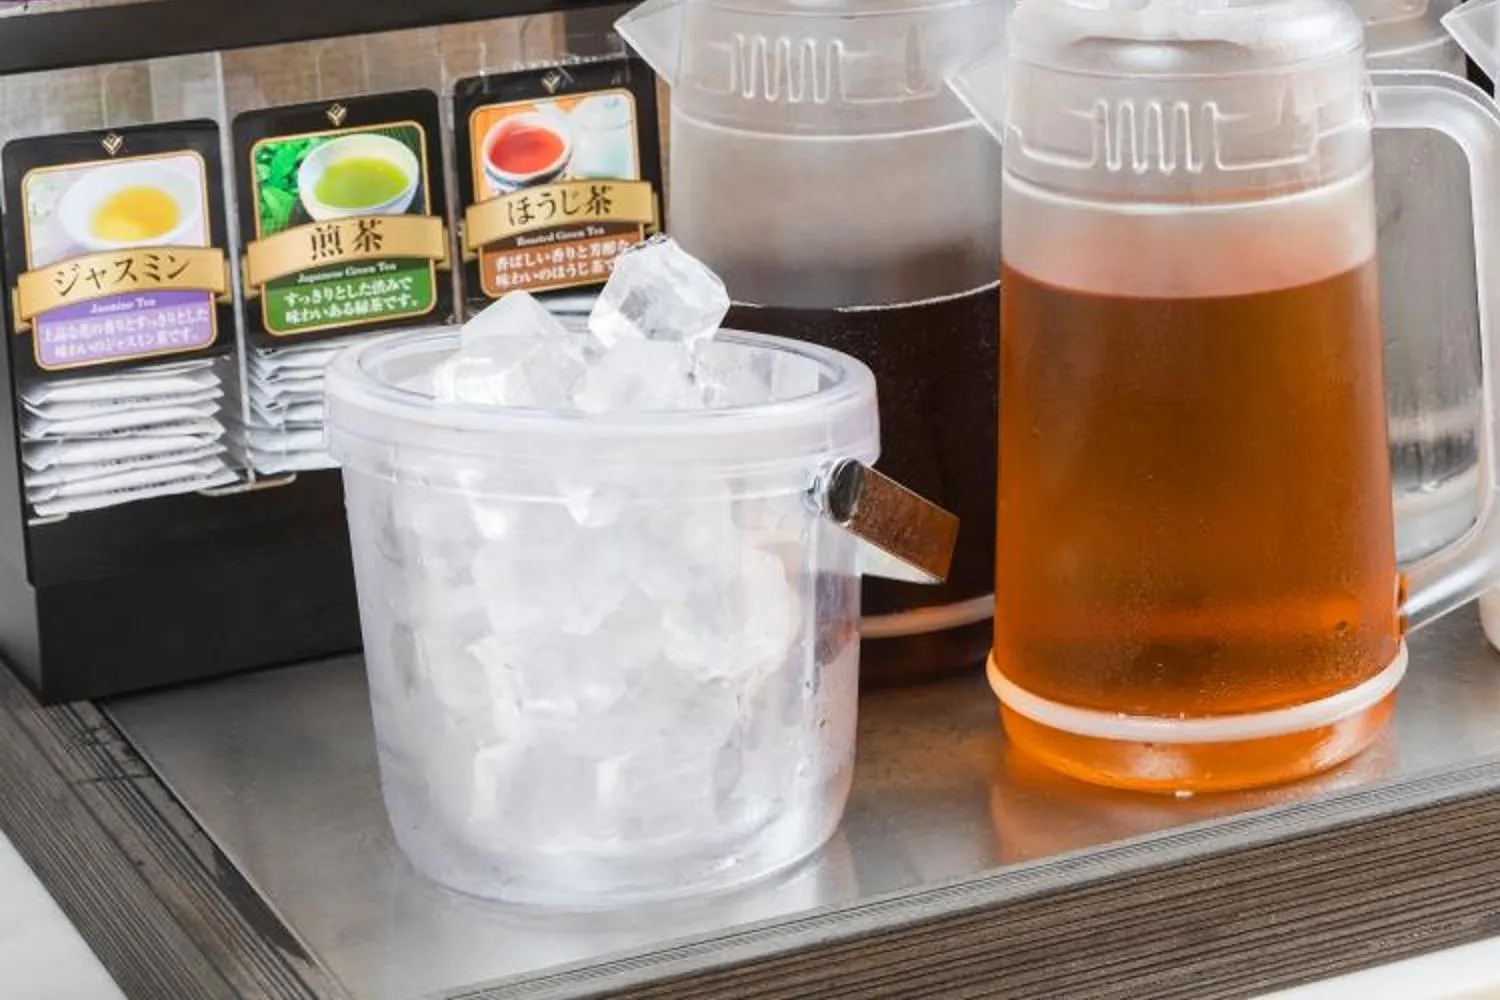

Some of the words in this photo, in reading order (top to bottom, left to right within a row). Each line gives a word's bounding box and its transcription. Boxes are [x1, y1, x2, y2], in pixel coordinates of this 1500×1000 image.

[507, 185, 616, 227] ほうじ茶
[310, 218, 384, 261] 煎茶
[516, 233, 555, 247] Roasted
[555, 228, 585, 242] Green
[586, 225, 606, 237] Tea
[53, 253, 191, 297] ジャスミン
[296, 270, 344, 285] Japanese
[345, 265, 376, 278] Green
[377, 261, 398, 273] Tea
[89, 300, 134, 314] Jasmine
[135, 297, 157, 309] Tea
